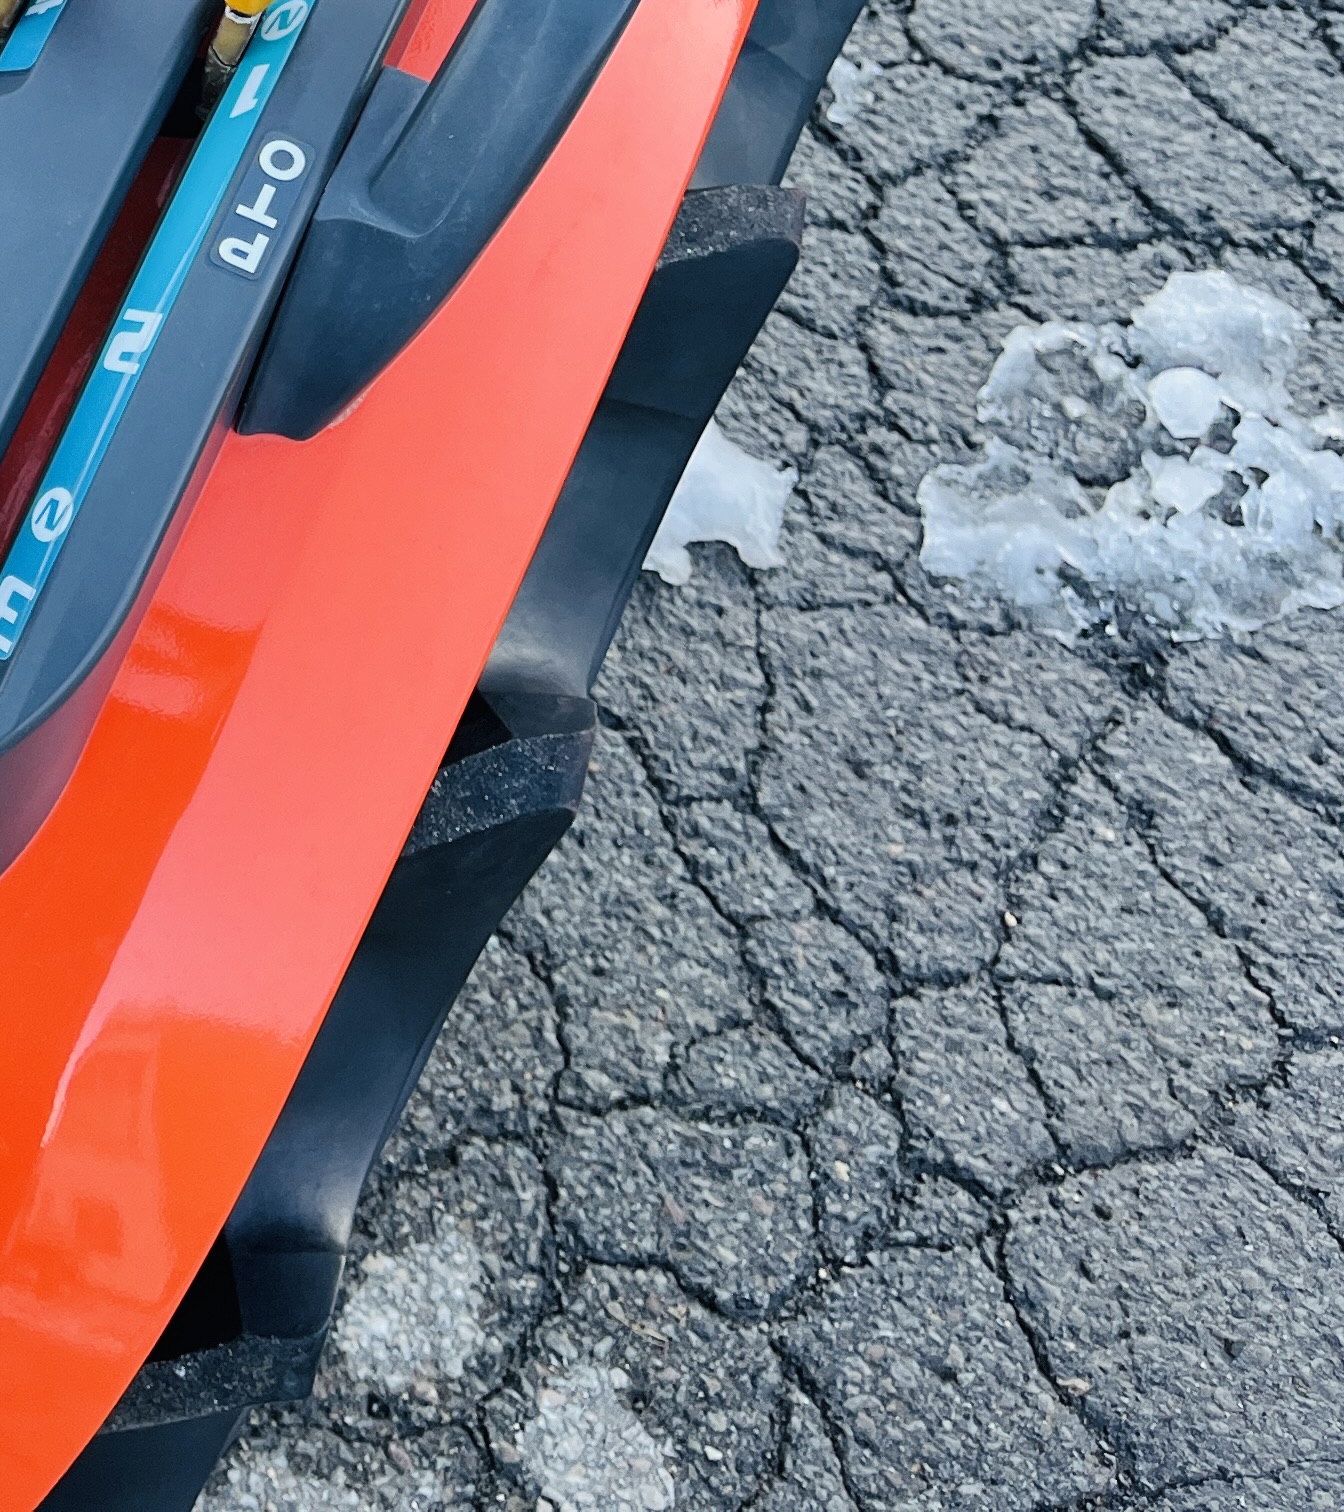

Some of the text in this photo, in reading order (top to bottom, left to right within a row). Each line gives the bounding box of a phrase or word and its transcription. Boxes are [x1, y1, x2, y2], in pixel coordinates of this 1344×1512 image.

[103, 302, 164, 373] 2
[229, 63, 268, 116] 1
[218, 138, 306, 275] PTO
